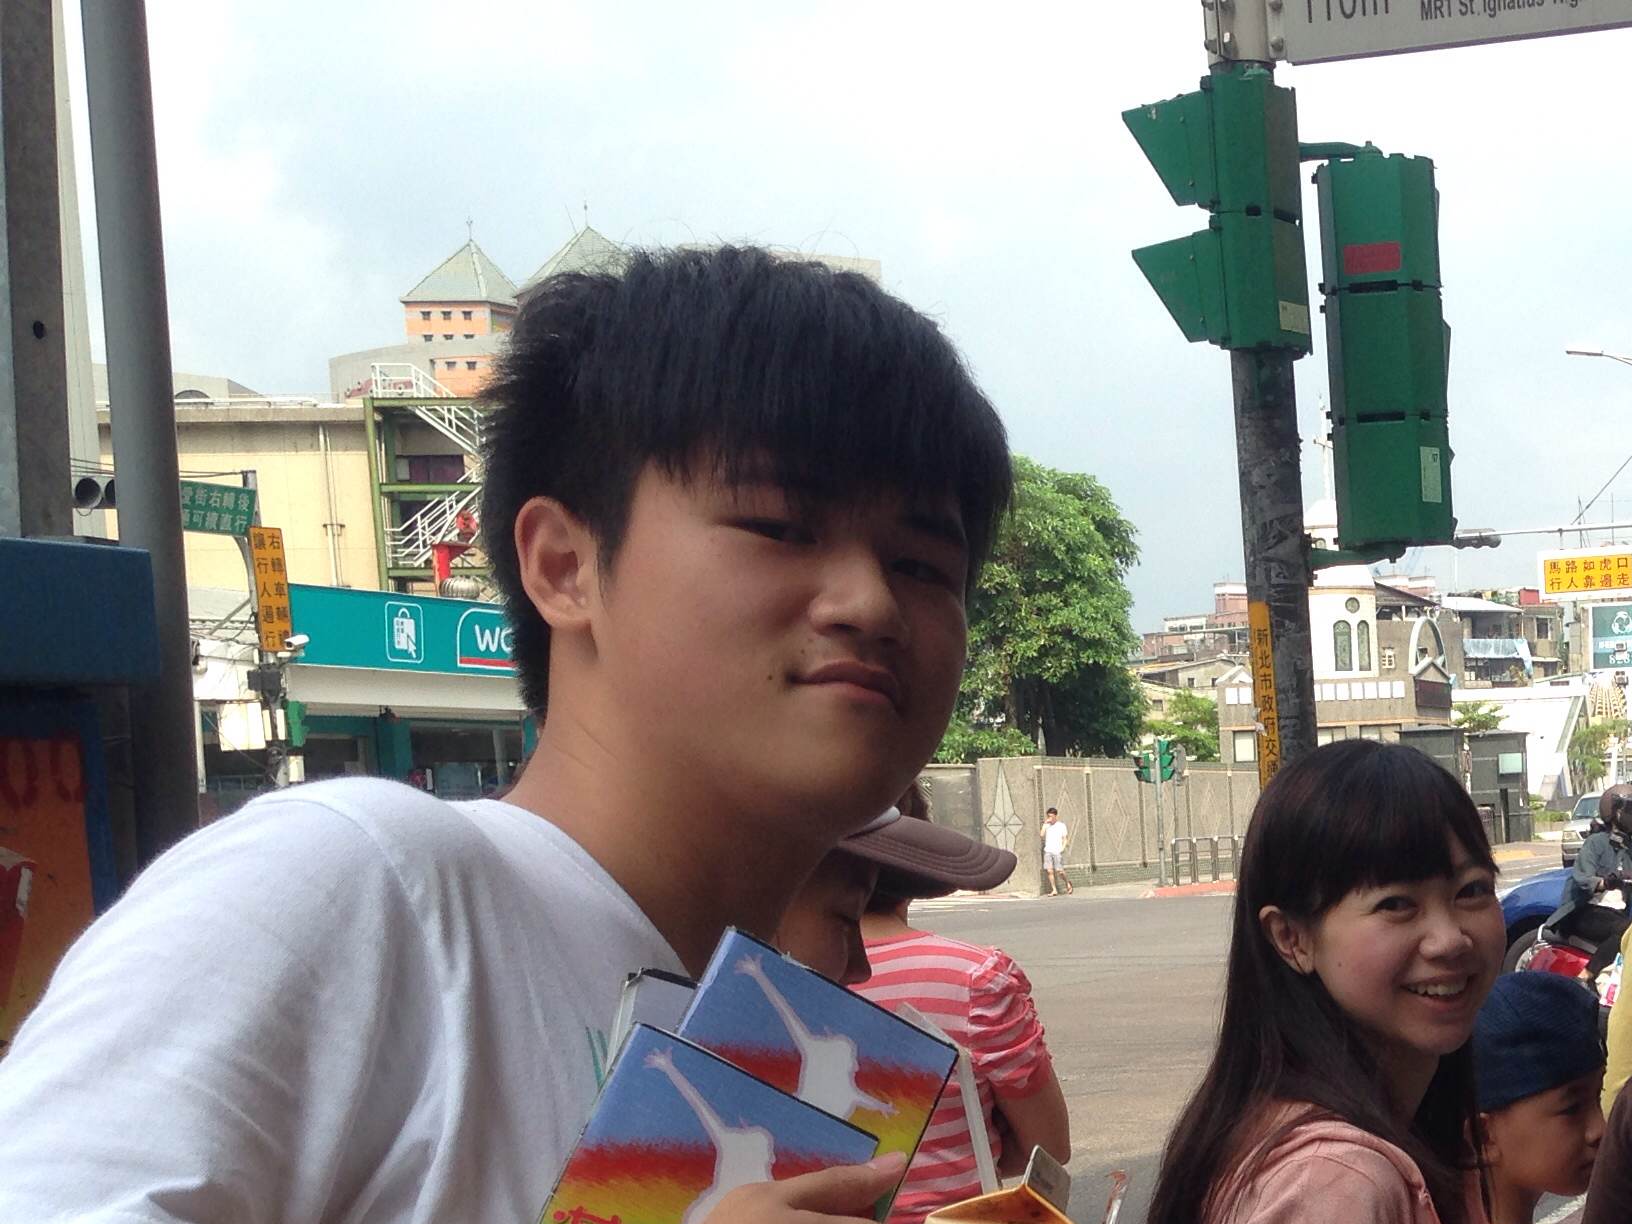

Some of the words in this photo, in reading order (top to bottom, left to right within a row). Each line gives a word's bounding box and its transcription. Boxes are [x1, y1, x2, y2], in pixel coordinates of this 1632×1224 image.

[1421, 0, 1452, 21] MRT
[1458, 0, 1482, 17] St.
[1549, 557, 1628, 574] 馬路如虎口
[1550, 575, 1630, 590] 行人靠邊走
